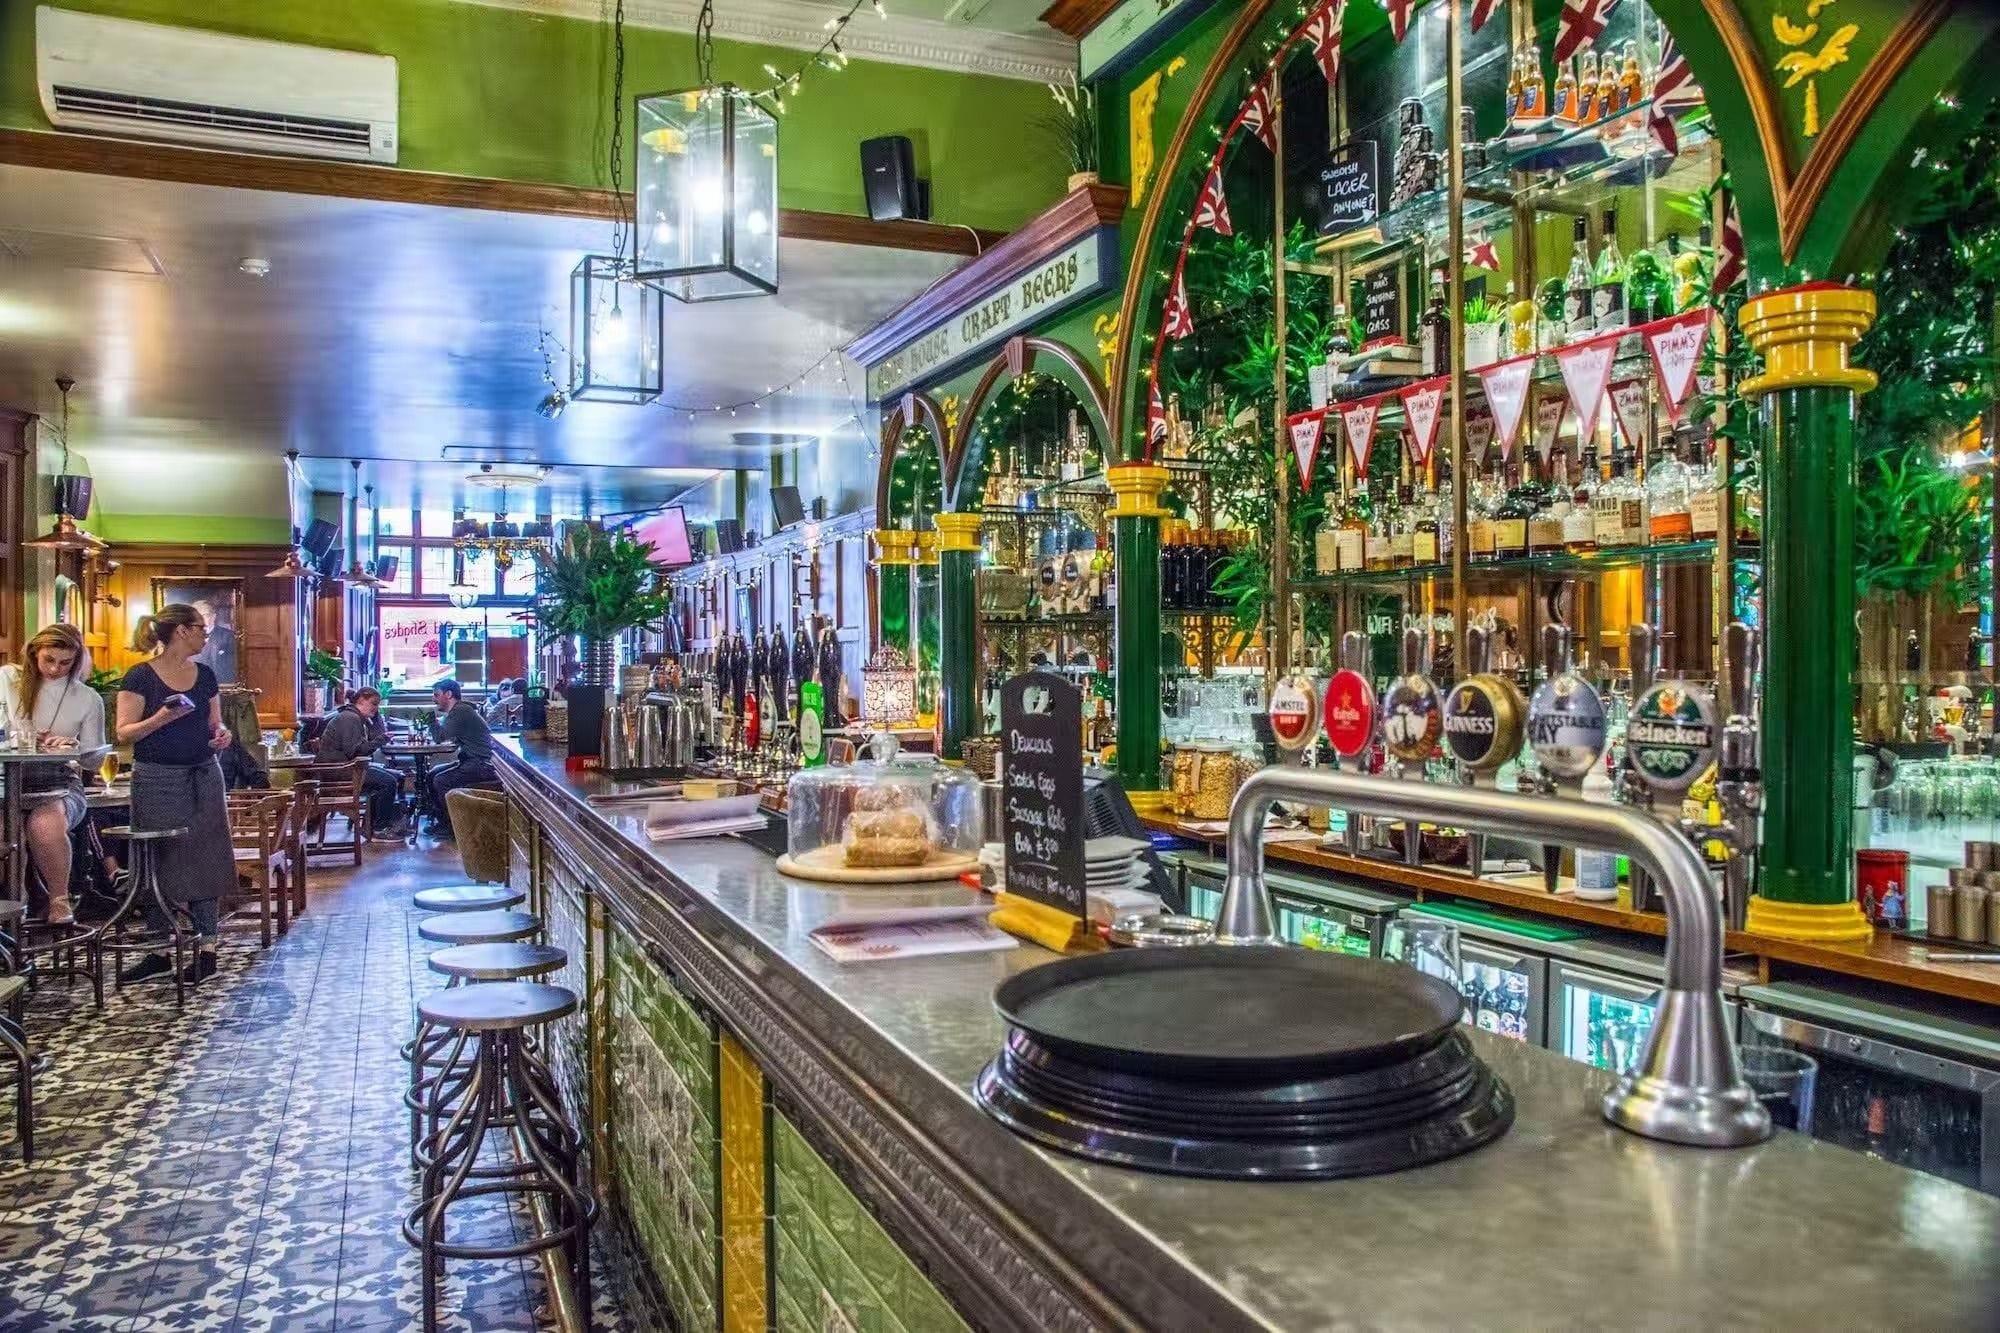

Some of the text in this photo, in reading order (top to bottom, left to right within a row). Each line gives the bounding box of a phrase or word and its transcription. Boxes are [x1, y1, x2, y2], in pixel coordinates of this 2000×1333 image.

[1321, 162, 1359, 181] SWEDISH
[1327, 172, 1371, 197] LAGER
[1333, 193, 1375, 215] ANYONE?
[961, 291, 1011, 343] CRAFT
[1021, 251, 1079, 311] BEERS
[1379, 304, 1385, 316] A
[1366, 318, 1391, 334] GLASS
[1660, 331, 1696, 354] PIMM'S
[1411, 395, 1435, 414] PIMM'S
[1350, 410, 1370, 427] PIMM'S
[1296, 424, 1315, 439] PIMM'S
[1594, 496, 1618, 511] KNOB
[1445, 715, 1494, 734] GUINNESS
[1629, 720, 1711, 745] Heineken
